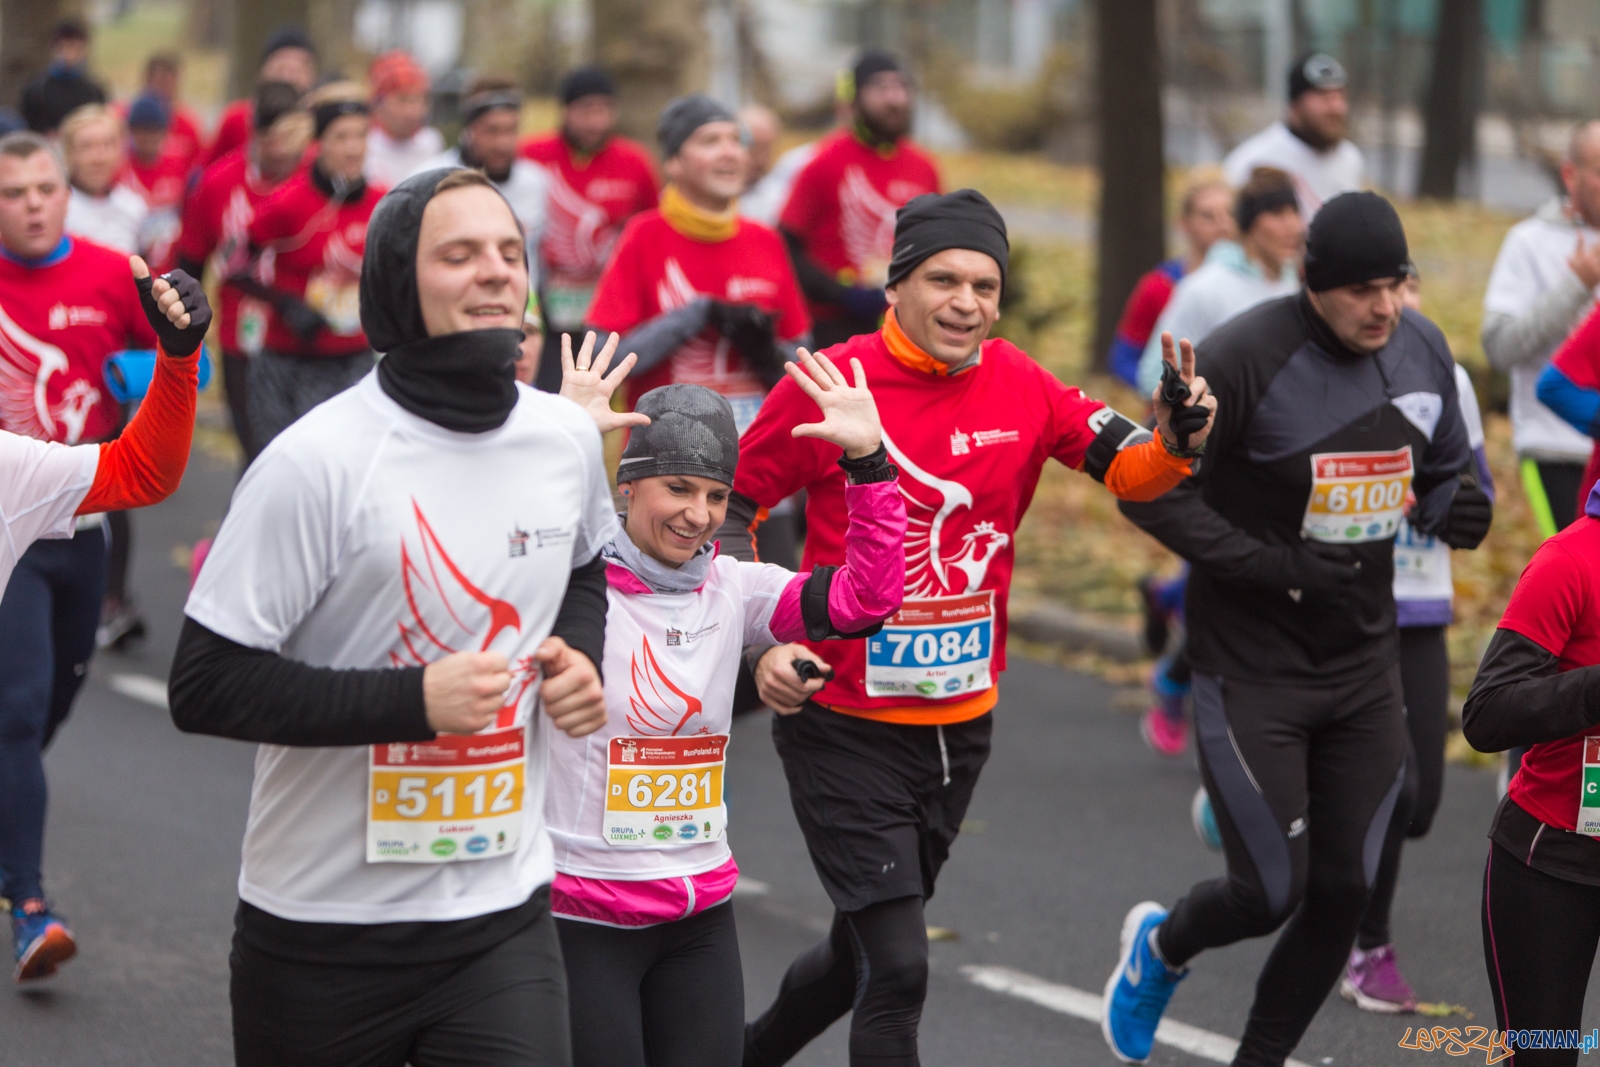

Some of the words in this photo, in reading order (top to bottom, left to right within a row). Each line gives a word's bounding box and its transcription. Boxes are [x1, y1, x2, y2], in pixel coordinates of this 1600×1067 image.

[1326, 480, 1403, 513] 6100
[941, 603, 985, 618] RunPoland.org
[871, 641, 882, 654] E
[886, 626, 982, 665] 7084
[640, 747, 646, 759] 1
[683, 747, 720, 757] RunPoland.org
[375, 789, 390, 804] D
[395, 771, 515, 818] 5112
[611, 783, 622, 796] D
[627, 770, 712, 808] 6281
[1586, 782, 1597, 794] C
[653, 813, 693, 823] Agnieszka
[610, 833, 637, 841] LUXMED
